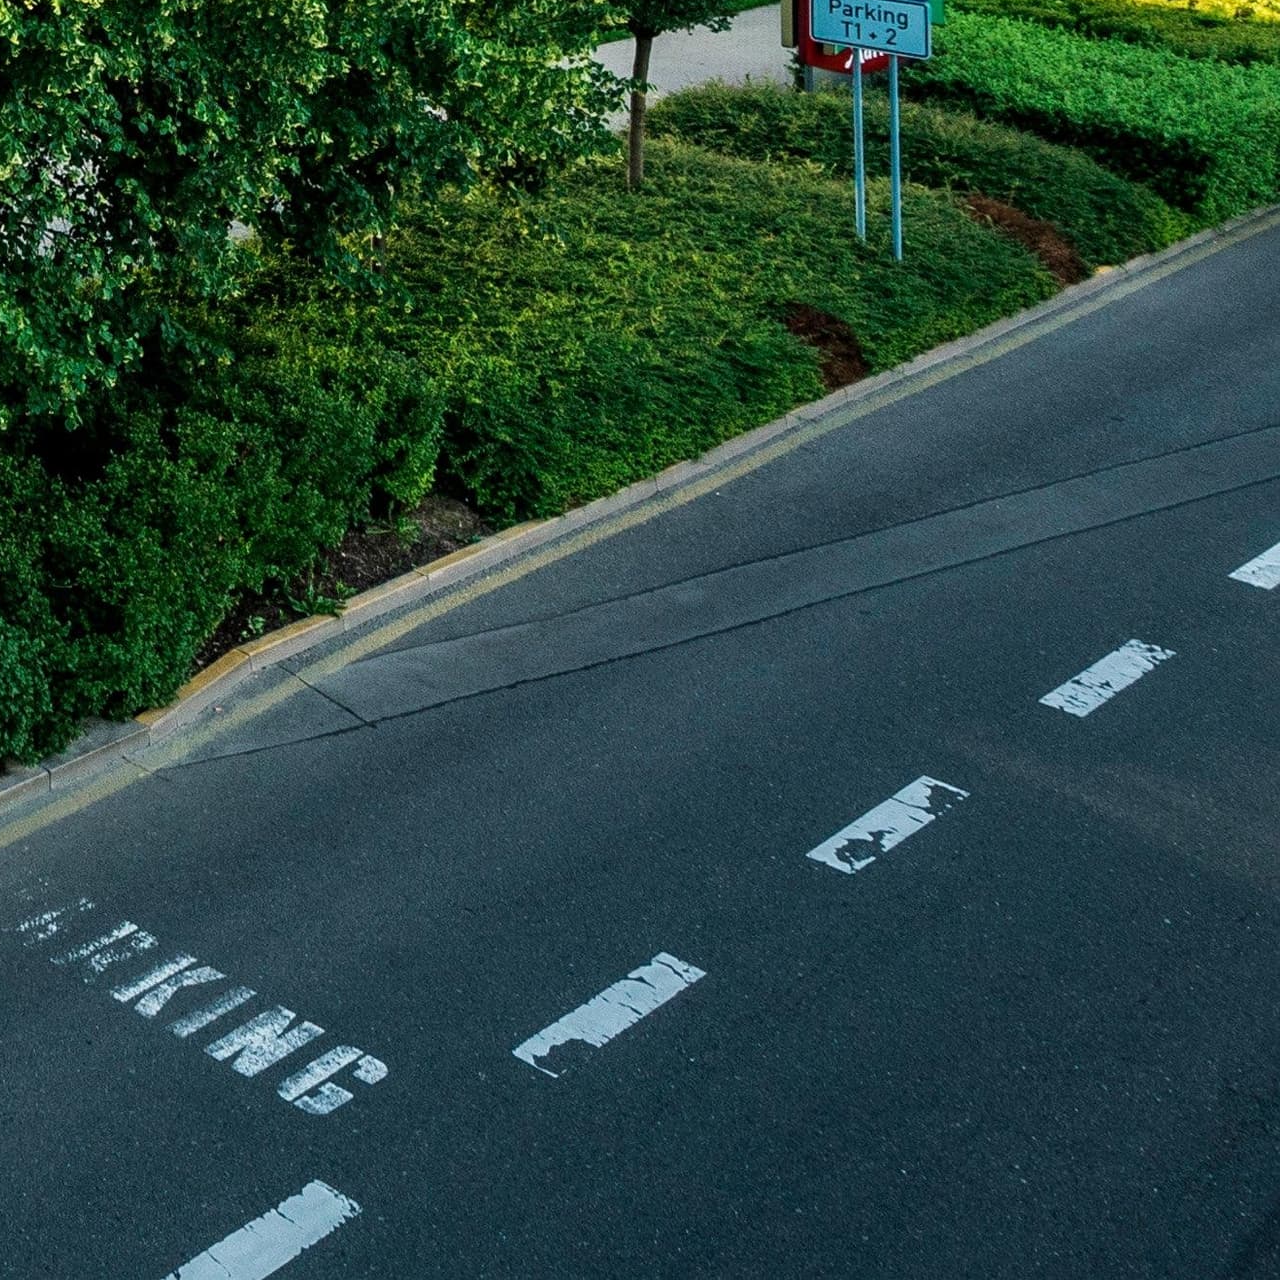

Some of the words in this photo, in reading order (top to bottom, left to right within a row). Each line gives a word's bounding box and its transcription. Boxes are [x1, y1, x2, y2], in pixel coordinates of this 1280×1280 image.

[841, 19, 861, 40] T1
[886, 28, 897, 46] 2
[0, 878, 389, 1116] RKING
